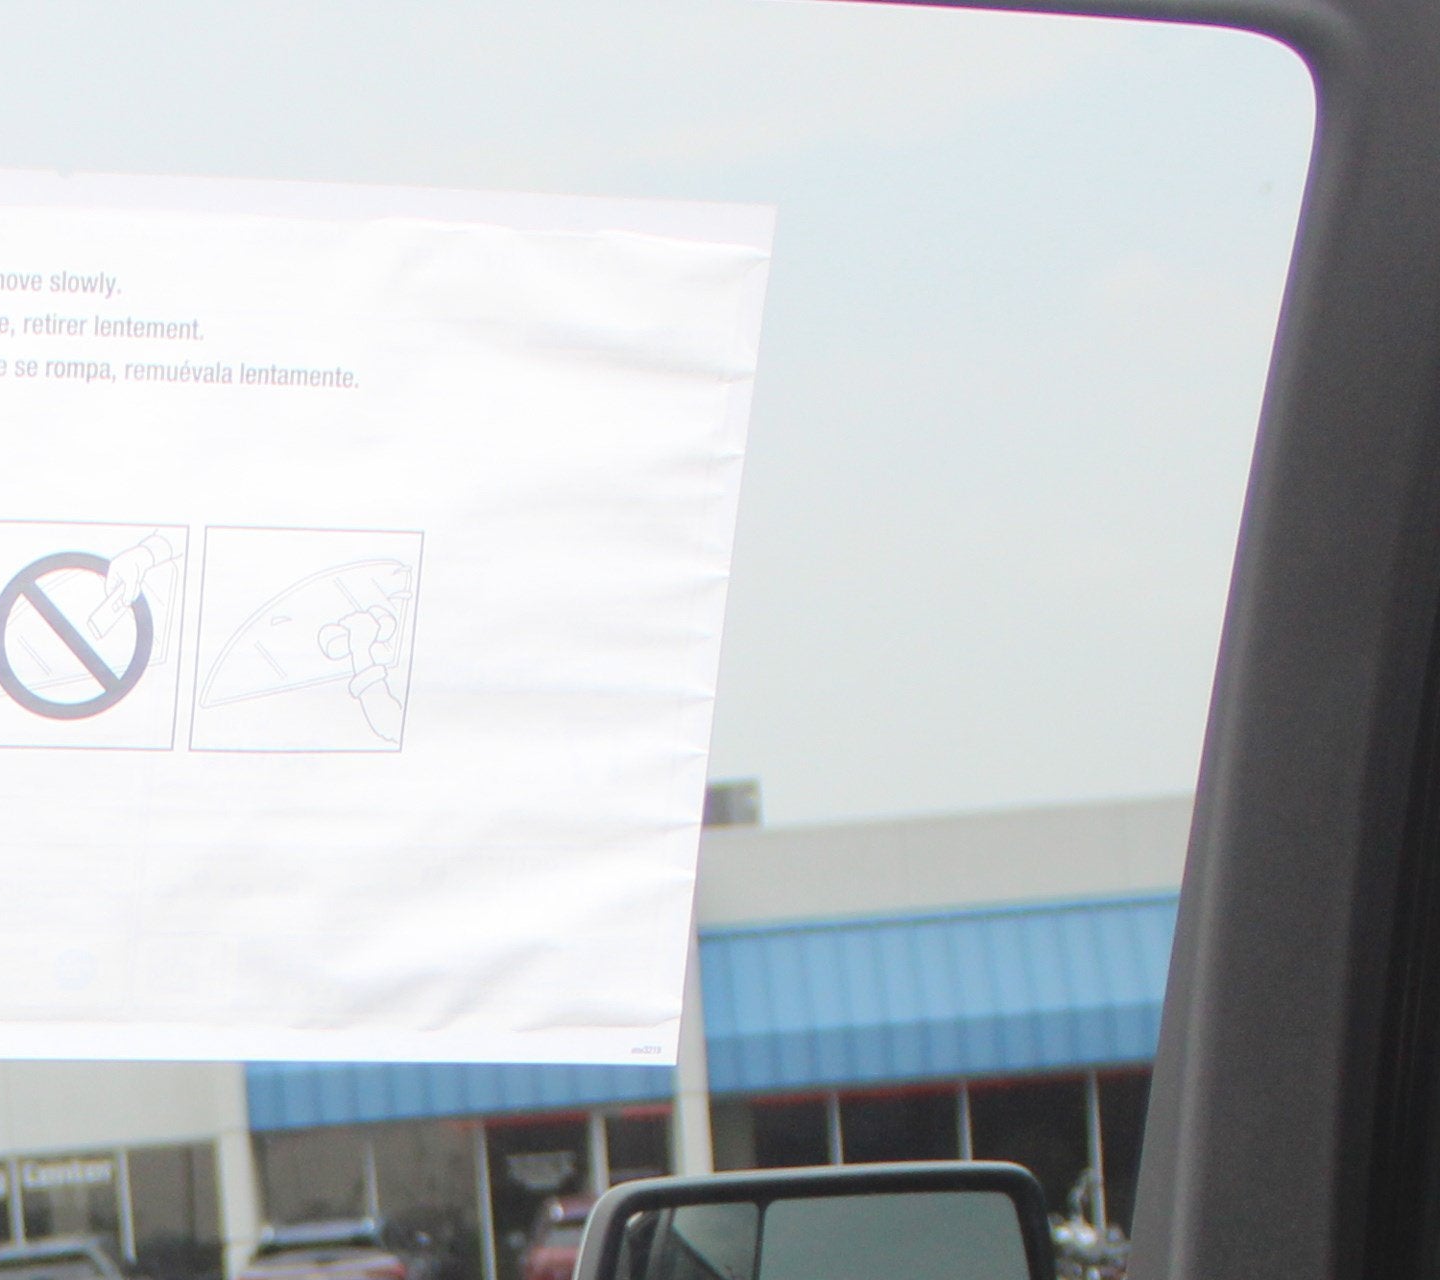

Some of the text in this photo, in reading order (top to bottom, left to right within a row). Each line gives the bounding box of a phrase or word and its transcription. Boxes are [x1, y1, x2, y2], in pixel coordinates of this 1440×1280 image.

[49, 270, 122, 299] slowly.
[23, 313, 87, 335] retirer
[93, 315, 204, 341] lentement.
[14, 358, 38, 378] se
[45, 360, 117, 384] rompa,
[124, 359, 233, 385] remuévala
[239, 362, 360, 389] lentamente.
